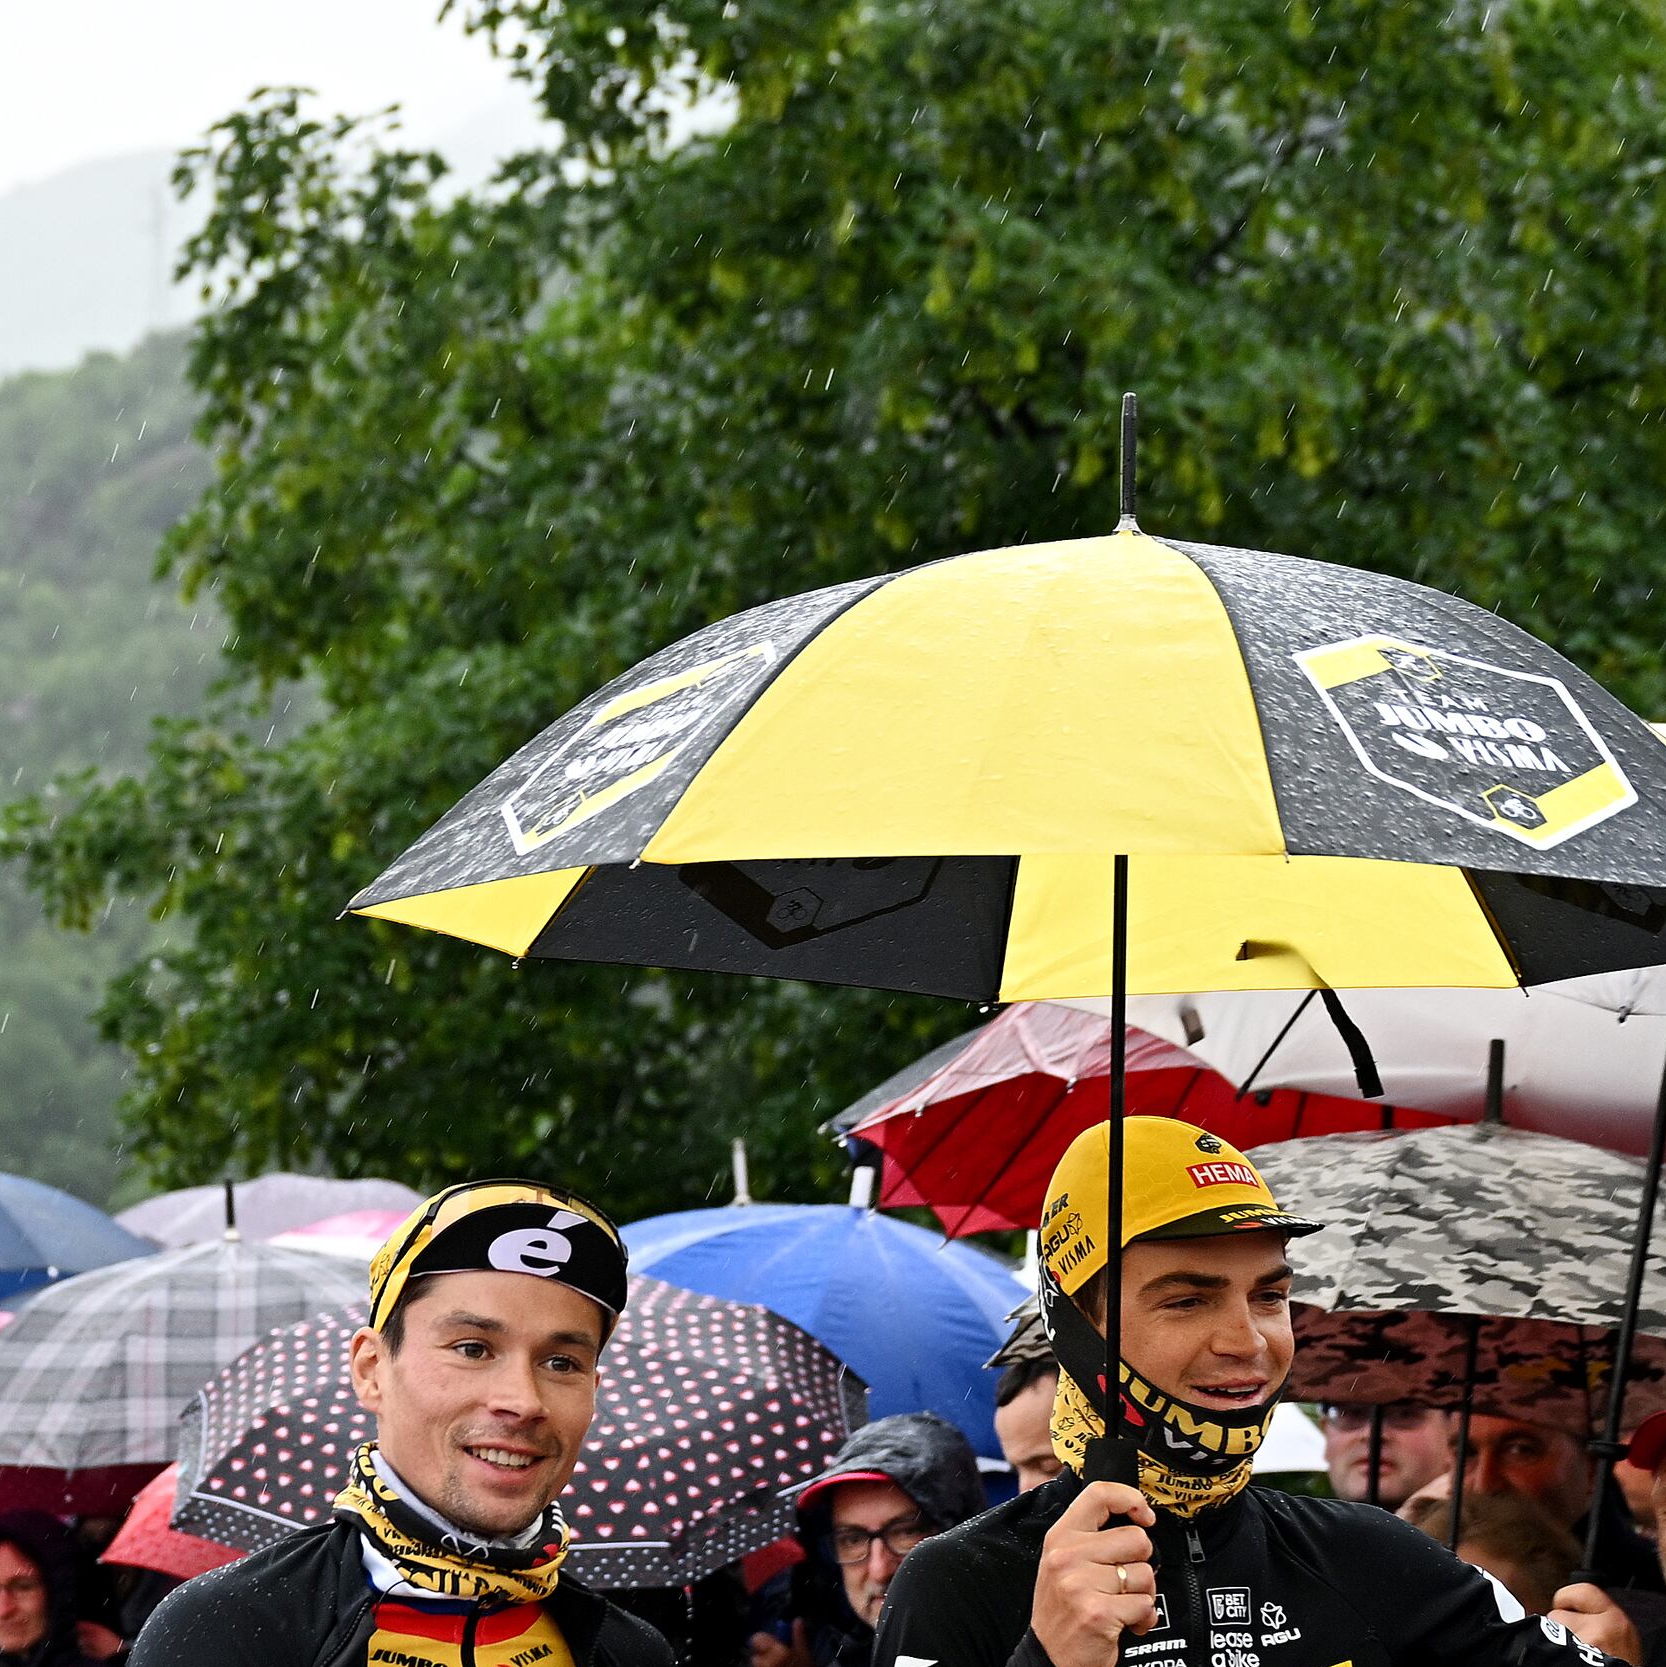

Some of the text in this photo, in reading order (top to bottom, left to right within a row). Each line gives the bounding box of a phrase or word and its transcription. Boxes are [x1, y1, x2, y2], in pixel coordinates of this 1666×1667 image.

[1392, 689, 1489, 712] TEAM
[1374, 702, 1547, 742] JUMBO
[1445, 736, 1572, 773] VISMA
[1191, 1164, 1257, 1187] HEMA
[1044, 1224, 1070, 1261] AGU
[1058, 1234, 1096, 1276] VISMA
[1225, 1593, 1245, 1606] BET
[1226, 1605, 1247, 1618] CITY
[1124, 1638, 1188, 1658] SRAM
[1210, 1630, 1254, 1650] lease
[1260, 1627, 1302, 1647] AGU
[510, 1643, 553, 1667] VISMA
